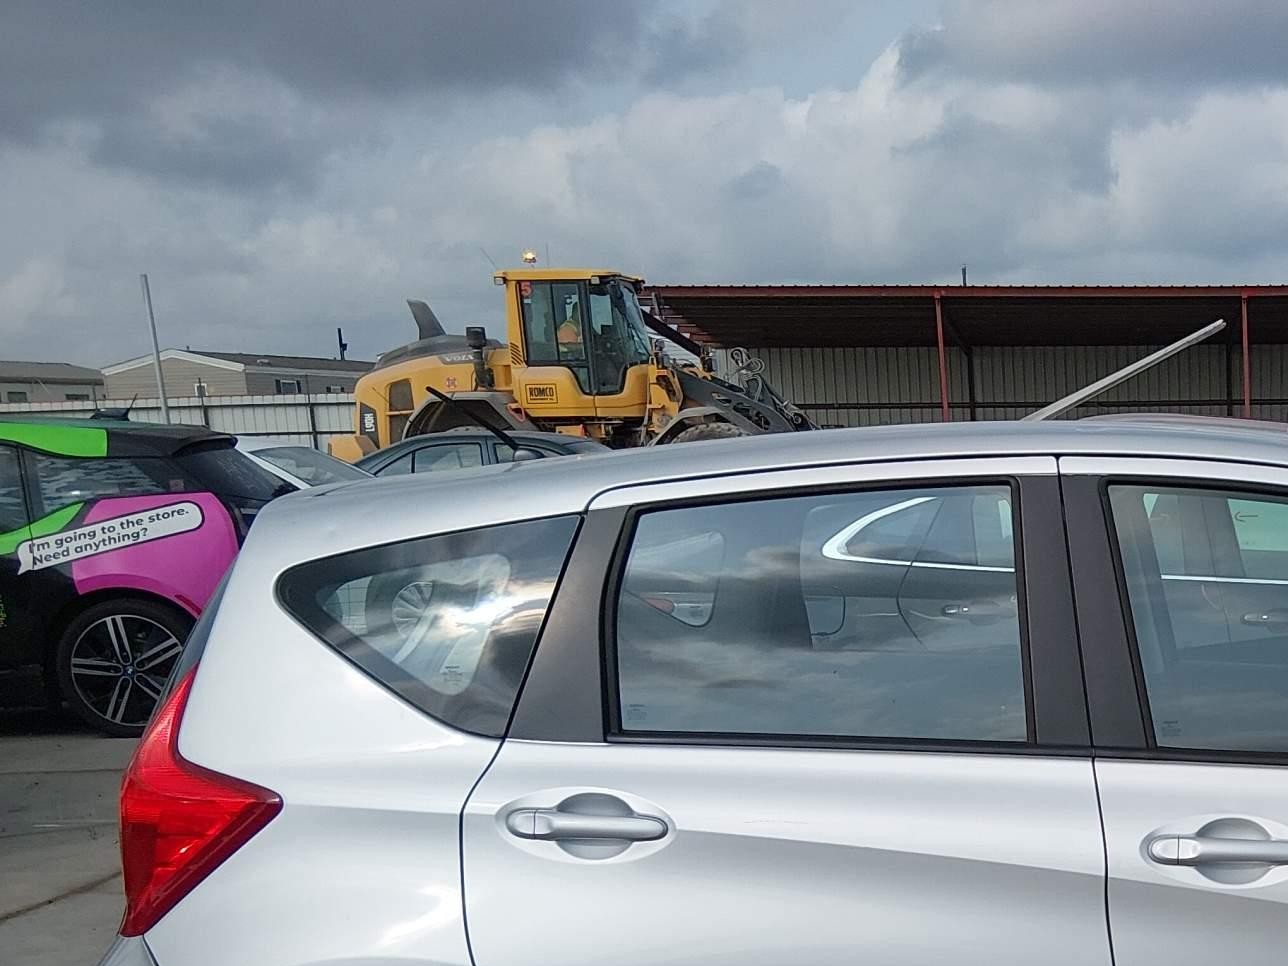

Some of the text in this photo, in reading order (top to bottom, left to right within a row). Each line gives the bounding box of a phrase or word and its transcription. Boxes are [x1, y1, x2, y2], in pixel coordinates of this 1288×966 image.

[528, 386, 554, 397] ROMCO
[28, 507, 190, 554] I'm going to the store.
[33, 527, 149, 566] Need anything?
